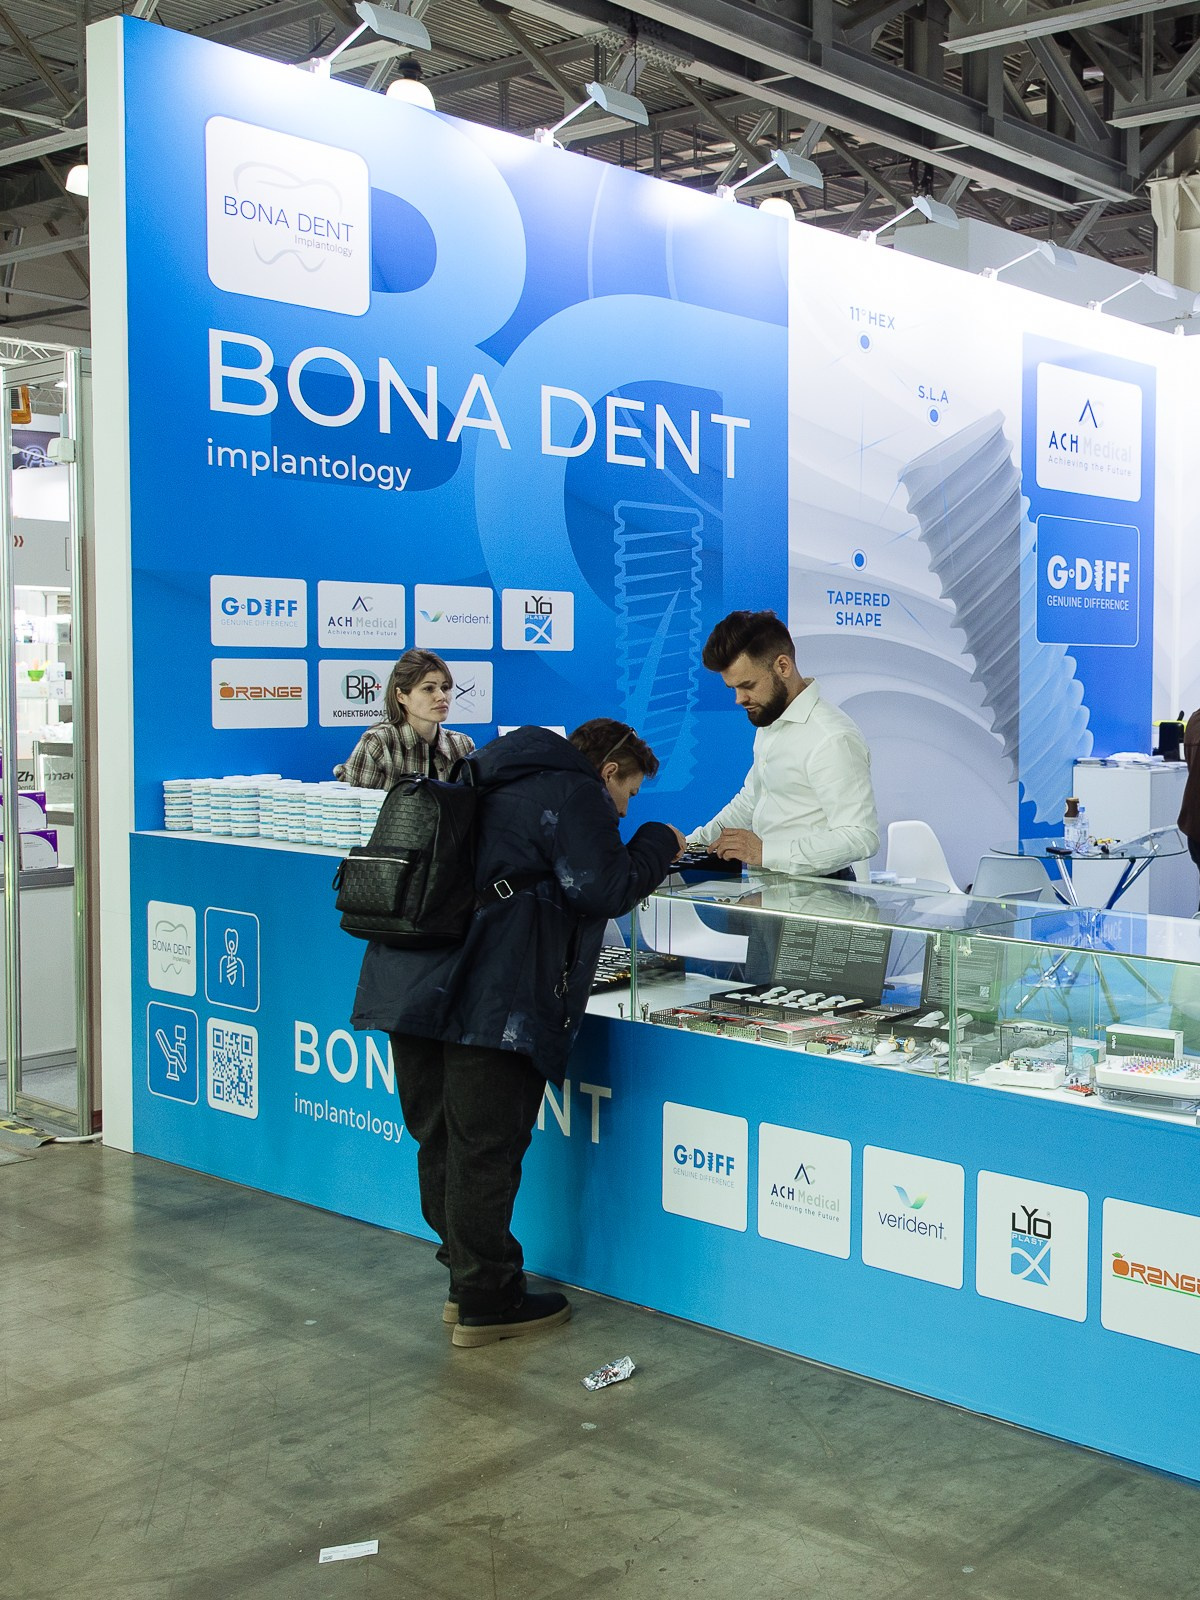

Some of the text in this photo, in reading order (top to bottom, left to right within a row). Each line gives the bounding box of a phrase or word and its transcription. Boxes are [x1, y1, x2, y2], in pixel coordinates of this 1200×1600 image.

[224, 195, 354, 242] BONA DENT
[868, 311, 895, 330] HEX
[208, 328, 750, 479] BONA DENT
[1048, 430, 1132, 463] ACH Medical
[206, 438, 412, 493] implantology
[1048, 455, 1132, 477] Achieving the Future
[525, 595, 552, 614] LYO
[826, 590, 891, 609] TAPERED
[1047, 595, 1129, 610] GENUINE DIFFERENCE
[254, 620, 298, 628] DIFFERENCE
[327, 616, 397, 629] ACH Medical
[835, 609, 883, 628] SHAPE
[327, 629, 361, 637] Achieving
[152, 939, 191, 956] BONA DENT
[294, 1021, 611, 1144] BON NT
[295, 1092, 404, 1144] implantology
[673, 1167, 735, 1189] GENUINE DIFFERENCE
[771, 1184, 840, 1212] ACH Medical
[771, 1200, 840, 1222] Achieving the Future
[1011, 1205, 1052, 1240] LYO
[1012, 1233, 1044, 1246] PLAST
